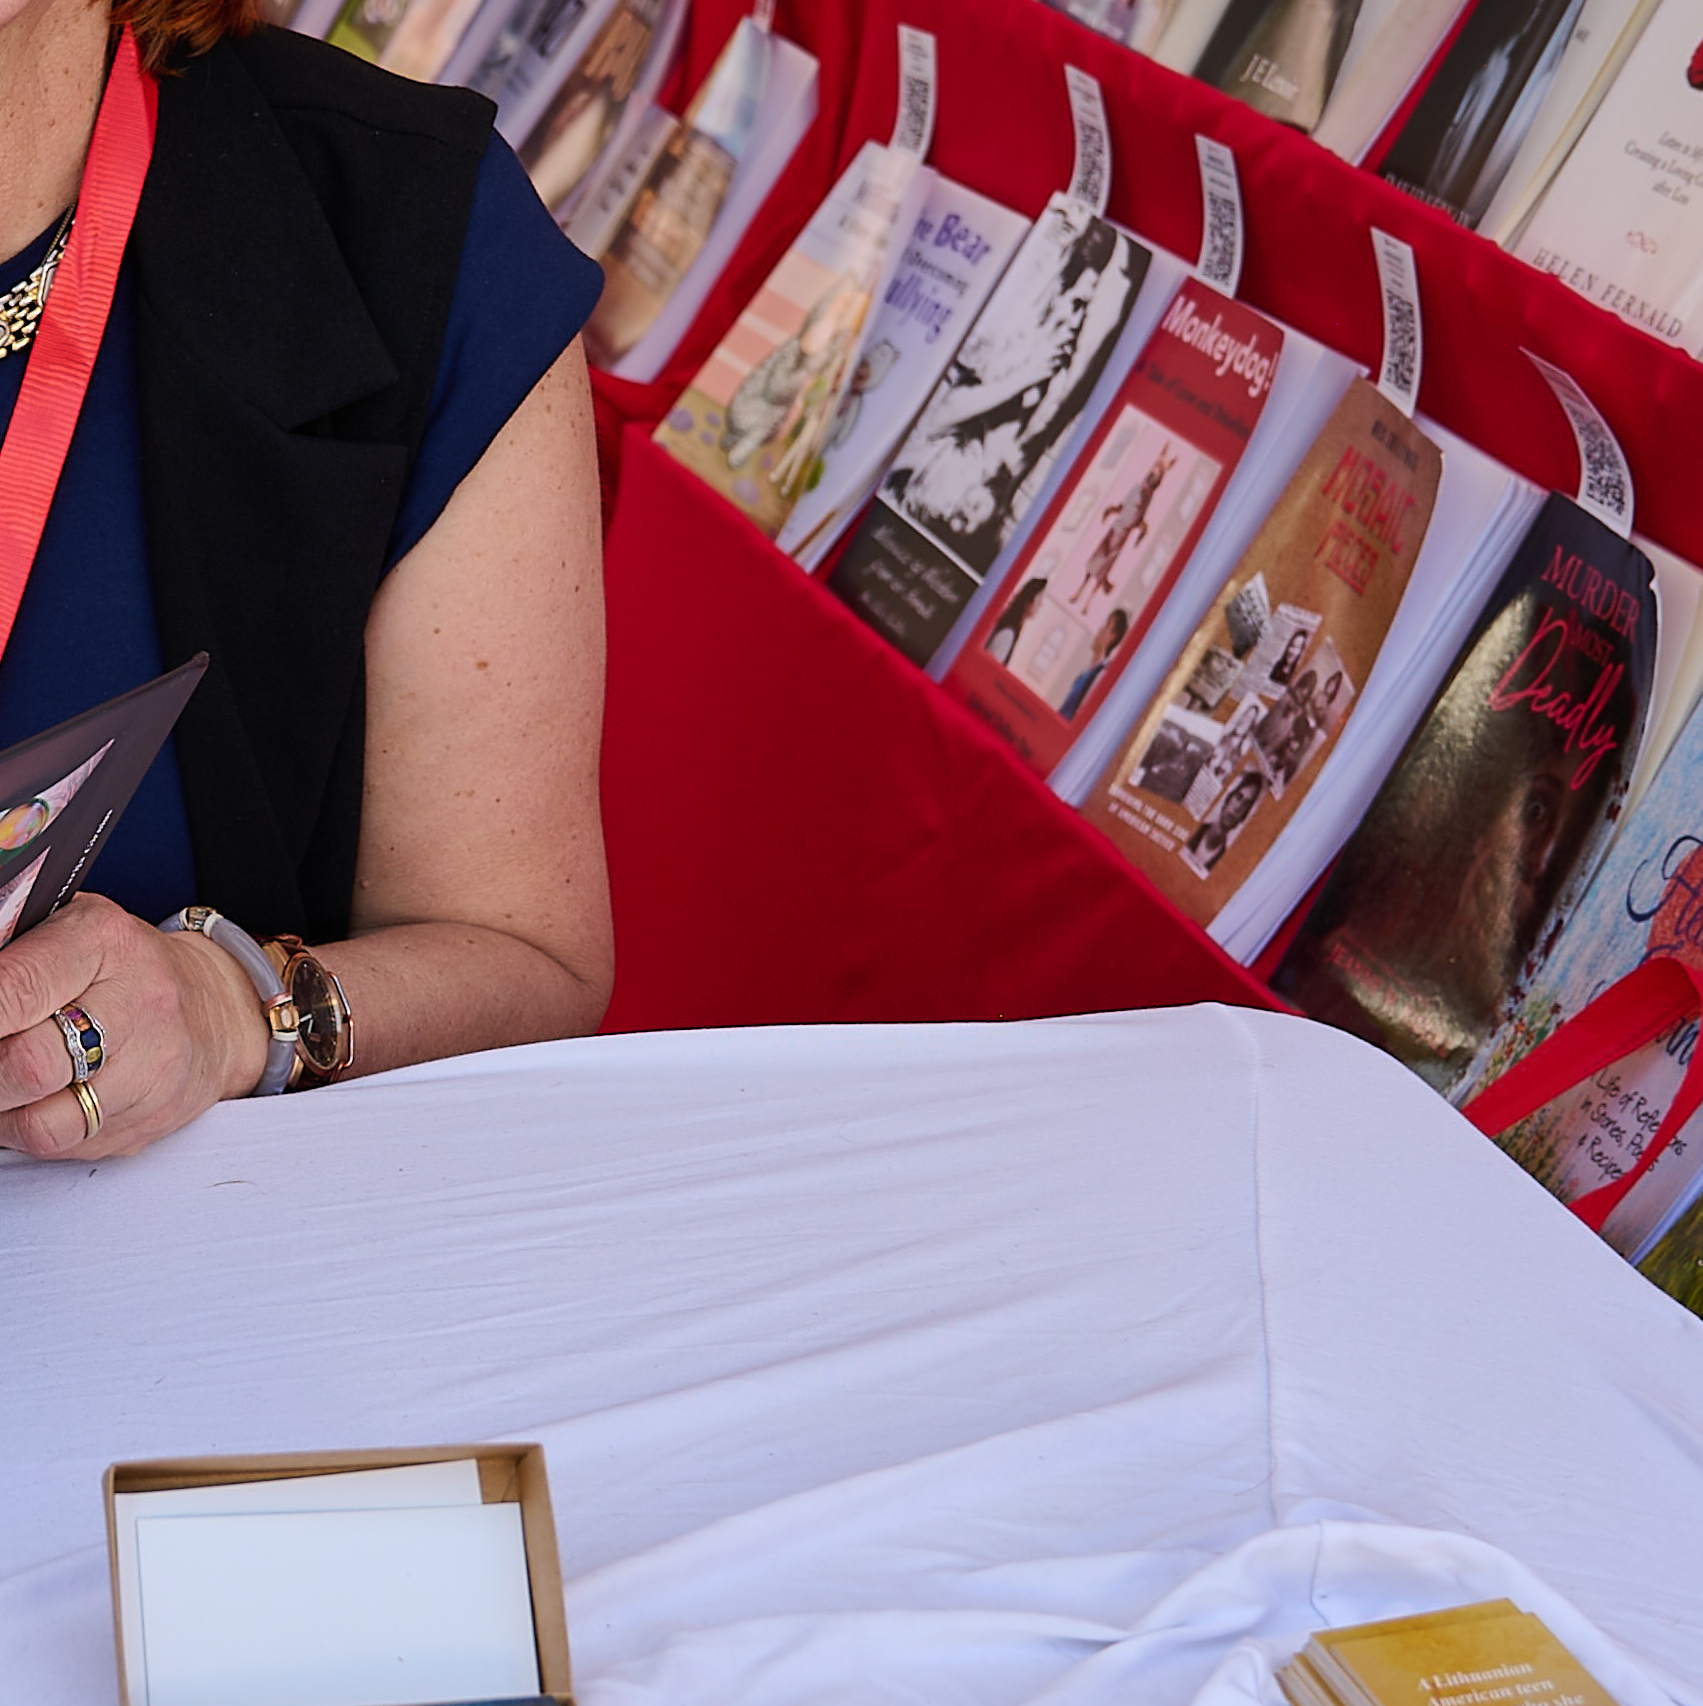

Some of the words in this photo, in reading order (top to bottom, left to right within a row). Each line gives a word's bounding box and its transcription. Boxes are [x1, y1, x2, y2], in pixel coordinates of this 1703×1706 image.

[934, 213, 990, 265] Bear
[1534, 246, 1599, 292] HELEN
[1601, 285, 1683, 338] FERNALD
[1163, 294, 1279, 401] Monkeydog!
[1540, 544, 1641, 643] MURDER
[1575, 622, 1615, 668] MOST
[1488, 607, 1625, 791] Deadly
[1618, 1091, 1638, 1113] of
[1586, 1137, 1623, 1181] Recipe
[1418, 1677, 1432, 1692] A
[1432, 1662, 1534, 1689] Lithuanian
[1516, 1679, 1555, 1694] teen
